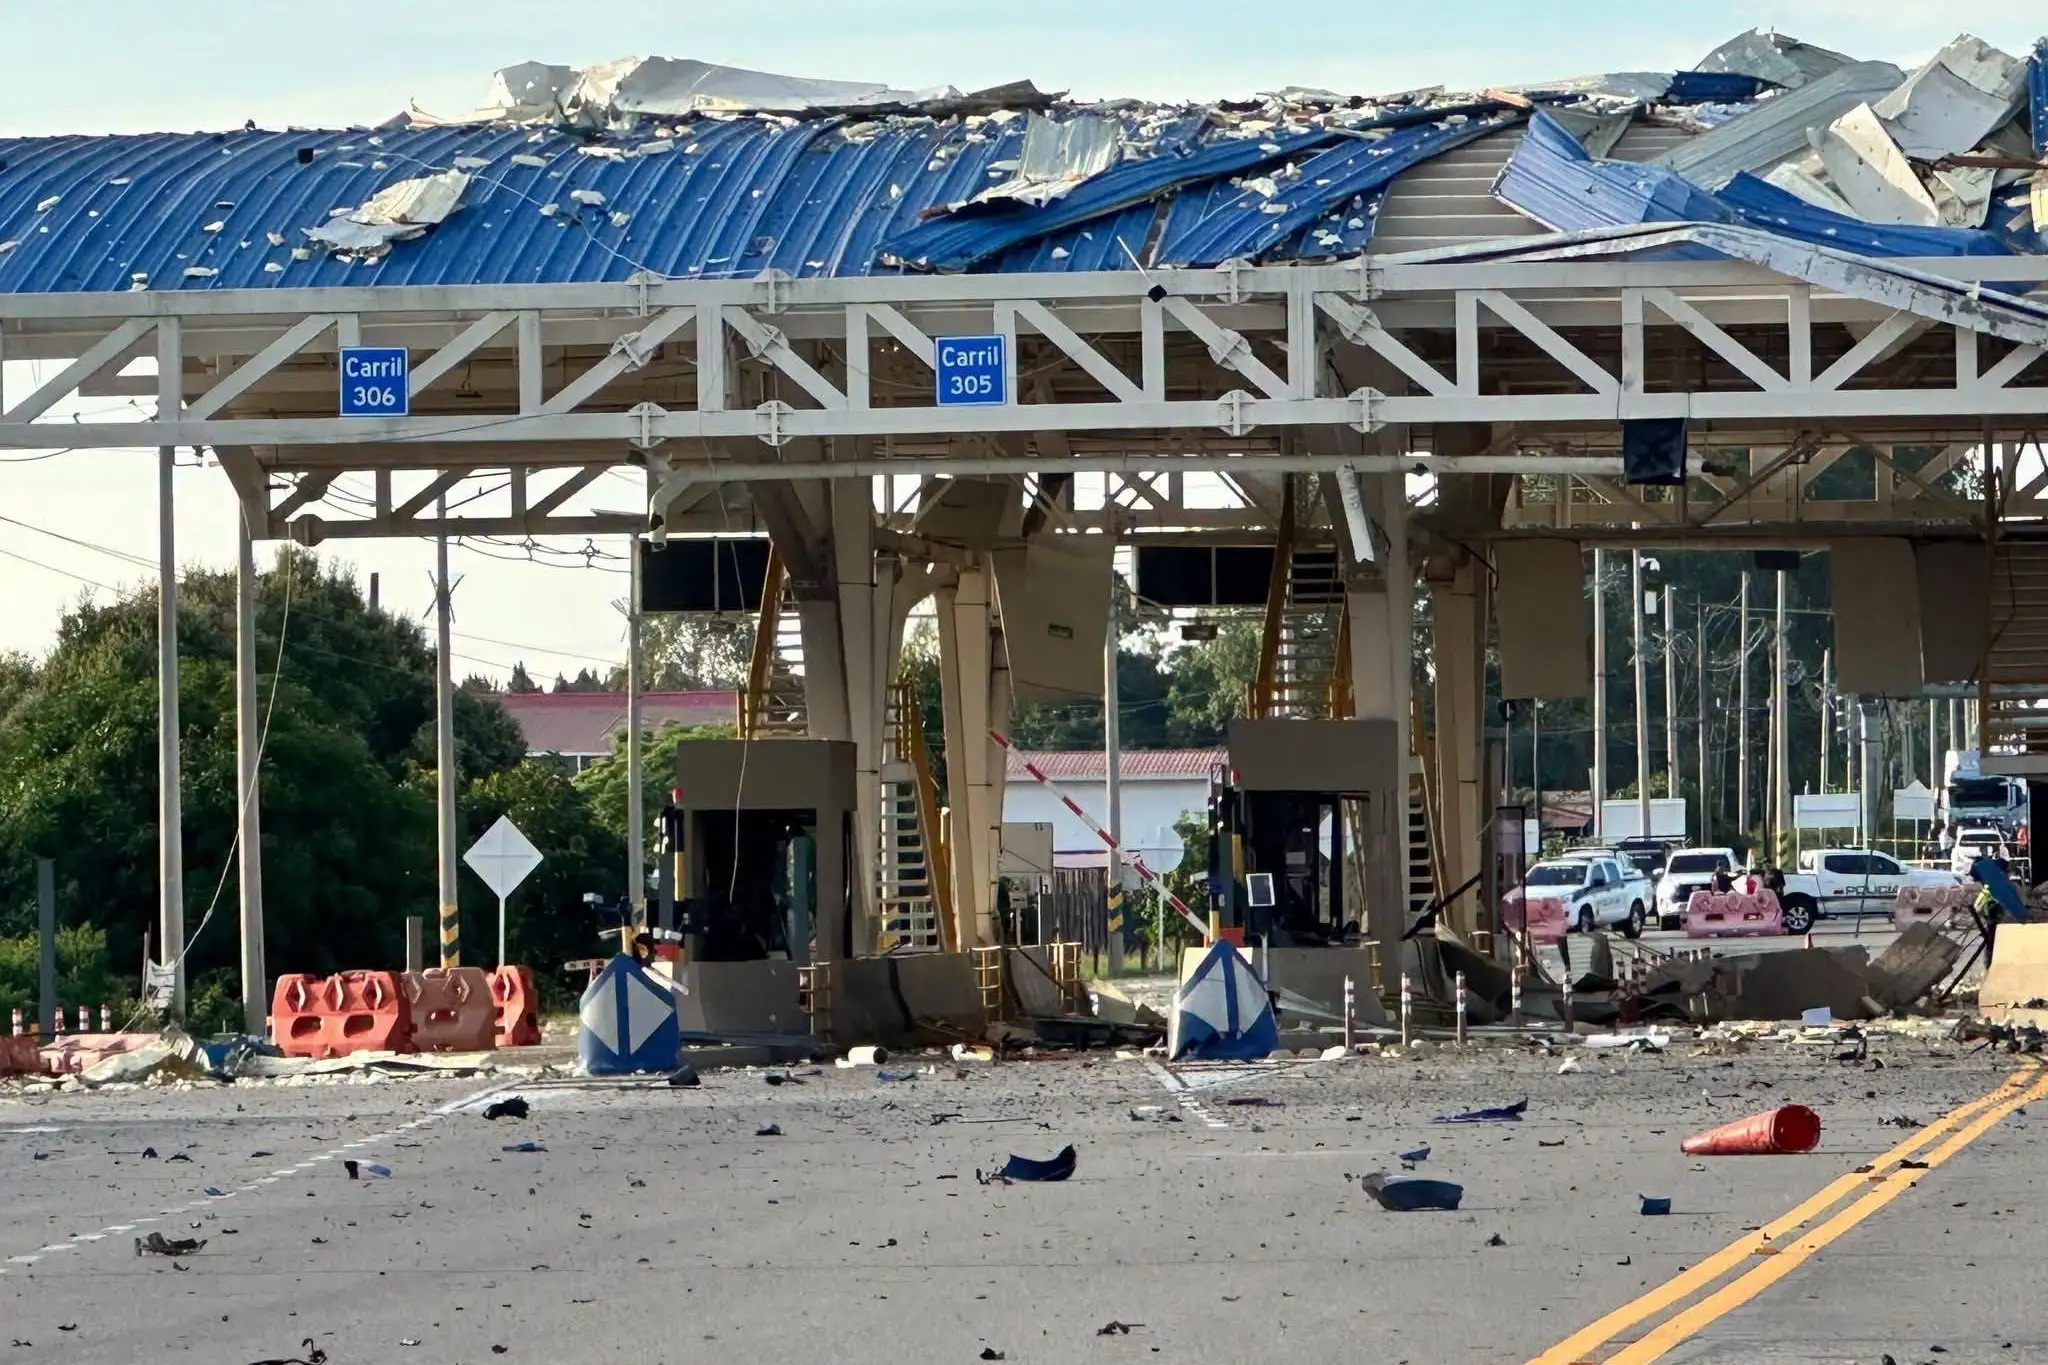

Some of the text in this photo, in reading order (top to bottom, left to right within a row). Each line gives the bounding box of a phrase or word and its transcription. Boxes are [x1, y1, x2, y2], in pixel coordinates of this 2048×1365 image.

[942, 346, 999, 367] Carril
[346, 357, 402, 378] Carril
[951, 375, 992, 395] 305
[353, 386, 396, 407] 306
